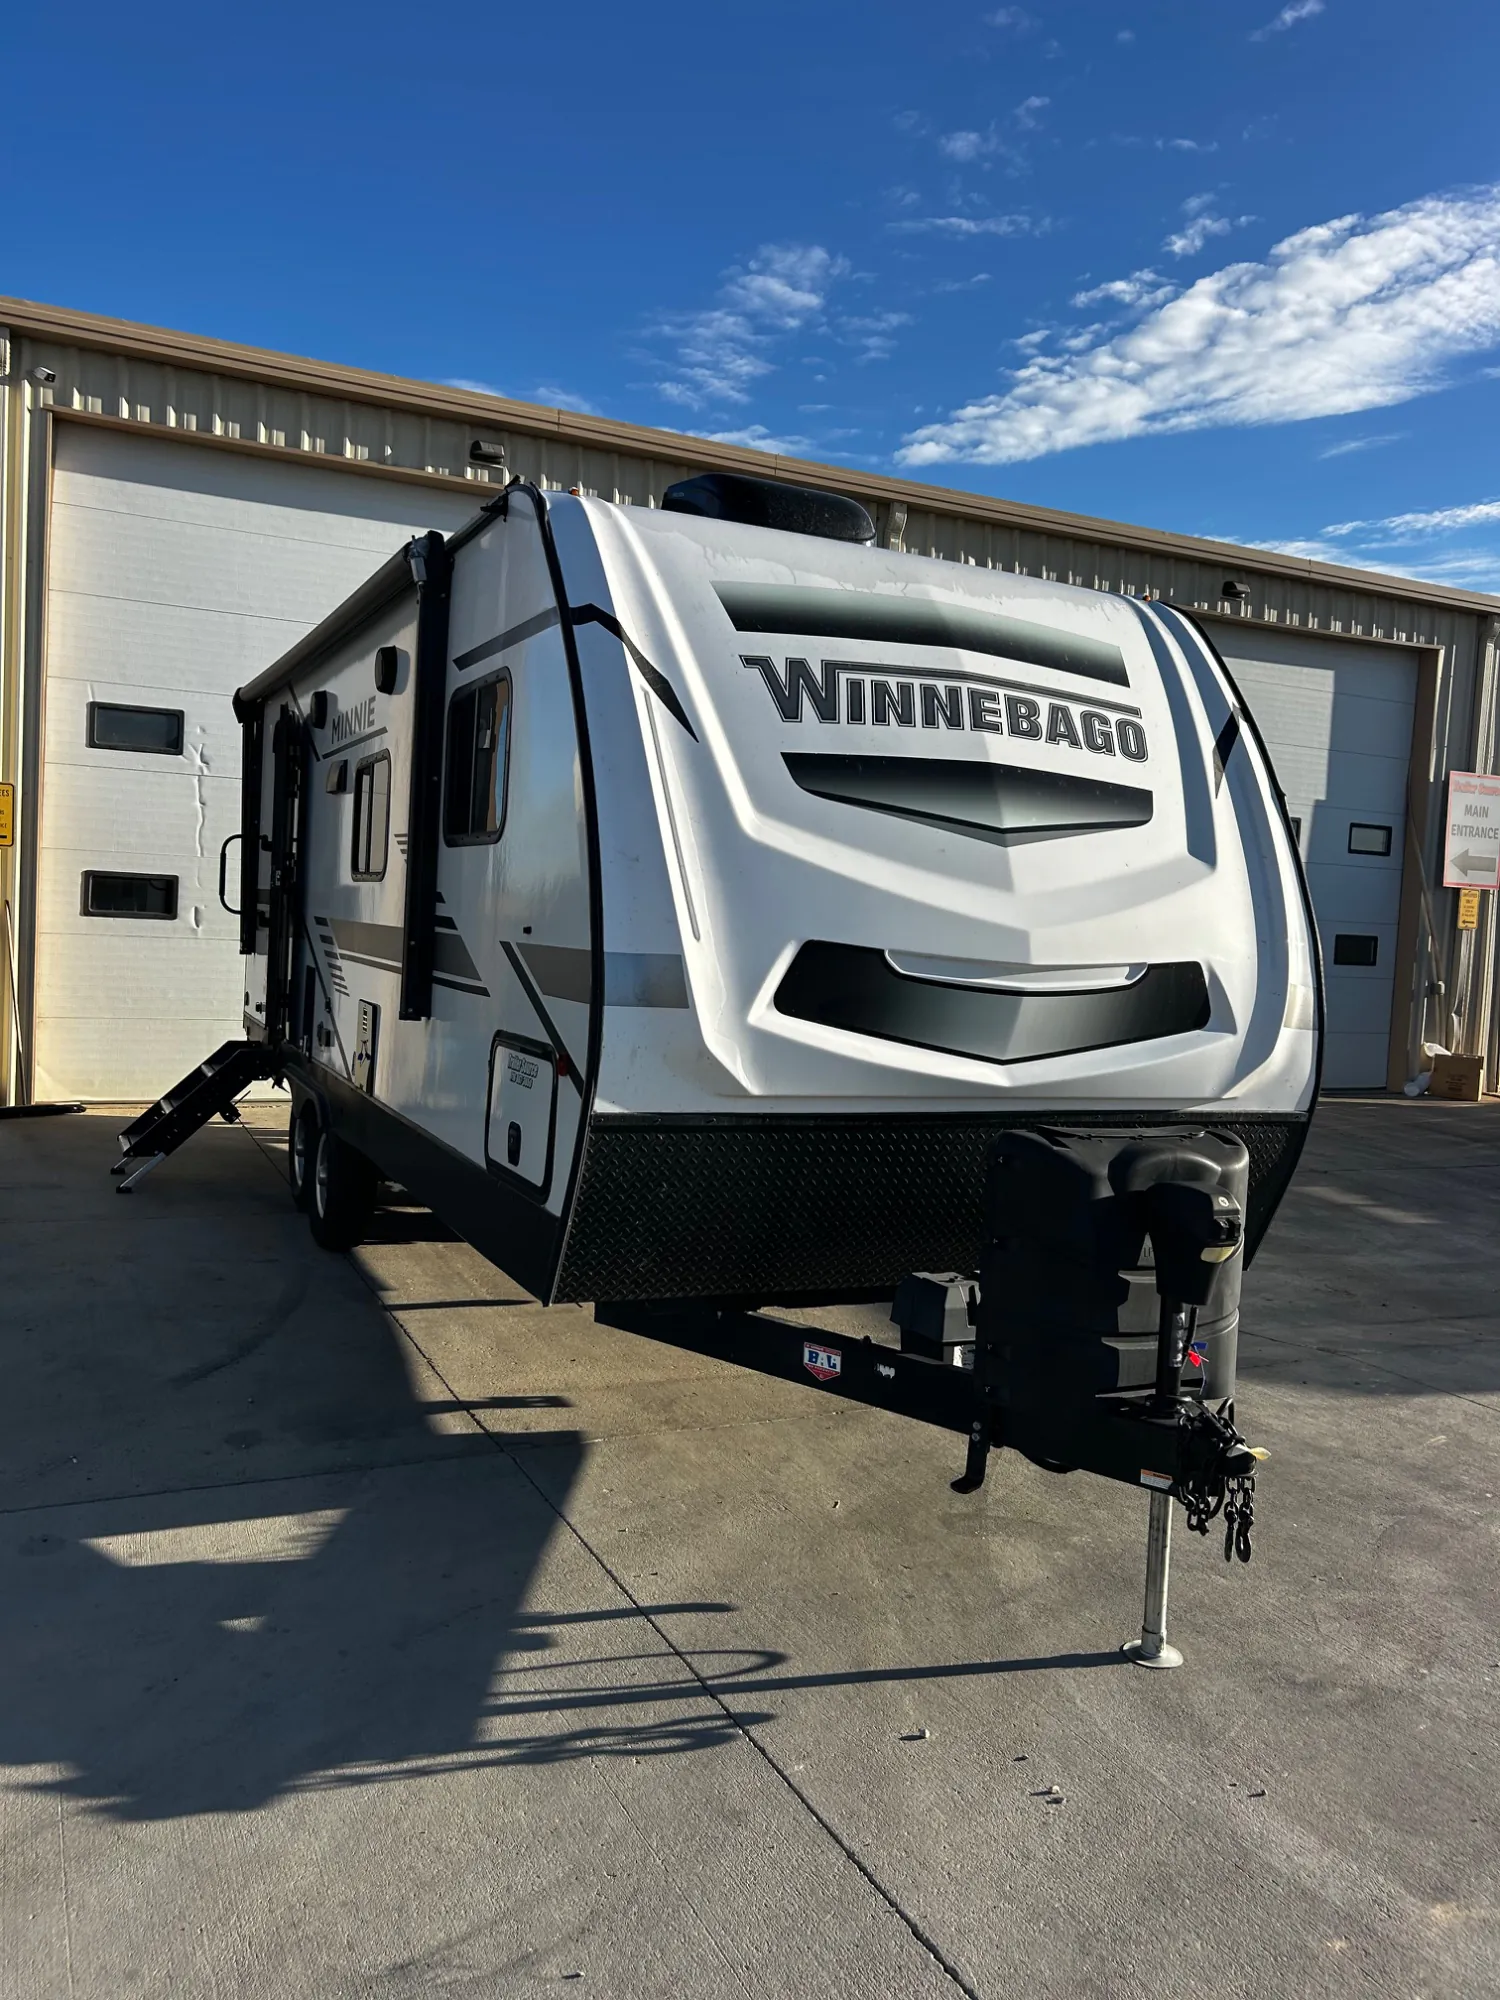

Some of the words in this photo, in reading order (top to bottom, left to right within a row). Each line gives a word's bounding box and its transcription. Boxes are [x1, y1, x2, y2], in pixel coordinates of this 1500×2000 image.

[331, 695, 376, 744] MINNIE
[738, 654, 1149, 763] WINNEBAGO
[1464, 804, 1489, 818] MAIN
[1451, 824, 1499, 840] ENTRANCE
